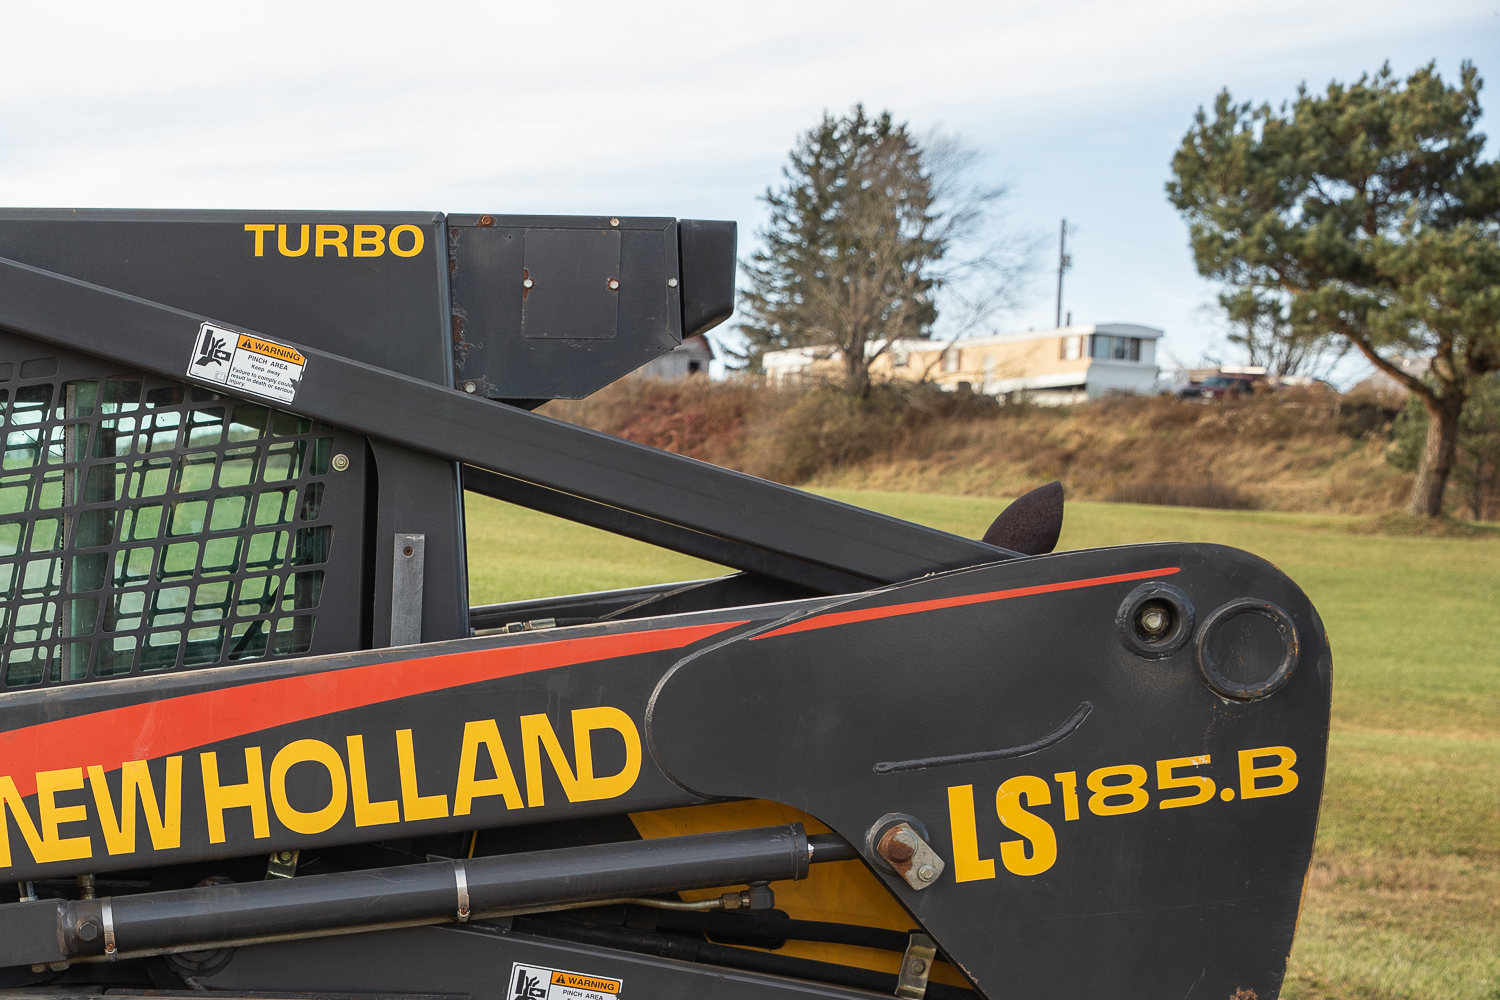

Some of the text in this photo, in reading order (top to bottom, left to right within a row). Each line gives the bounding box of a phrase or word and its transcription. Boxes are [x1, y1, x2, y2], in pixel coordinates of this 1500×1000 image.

[244, 224, 425, 257] TURBO
[255, 342, 301, 362] WARNING
[248, 354, 288, 371] PINCH AREA
[251, 364, 281, 377] Keep away
[230, 373, 246, 381] result
[252, 379, 267, 388] death
[274, 385, 293, 395] serious
[232, 366, 252, 377] Failure
[257, 374, 278, 384] comply
[200, 706, 642, 845] HOLLAND
[568, 977, 614, 991] WARNING
[562, 989, 604, 1000] PINCH AREA
